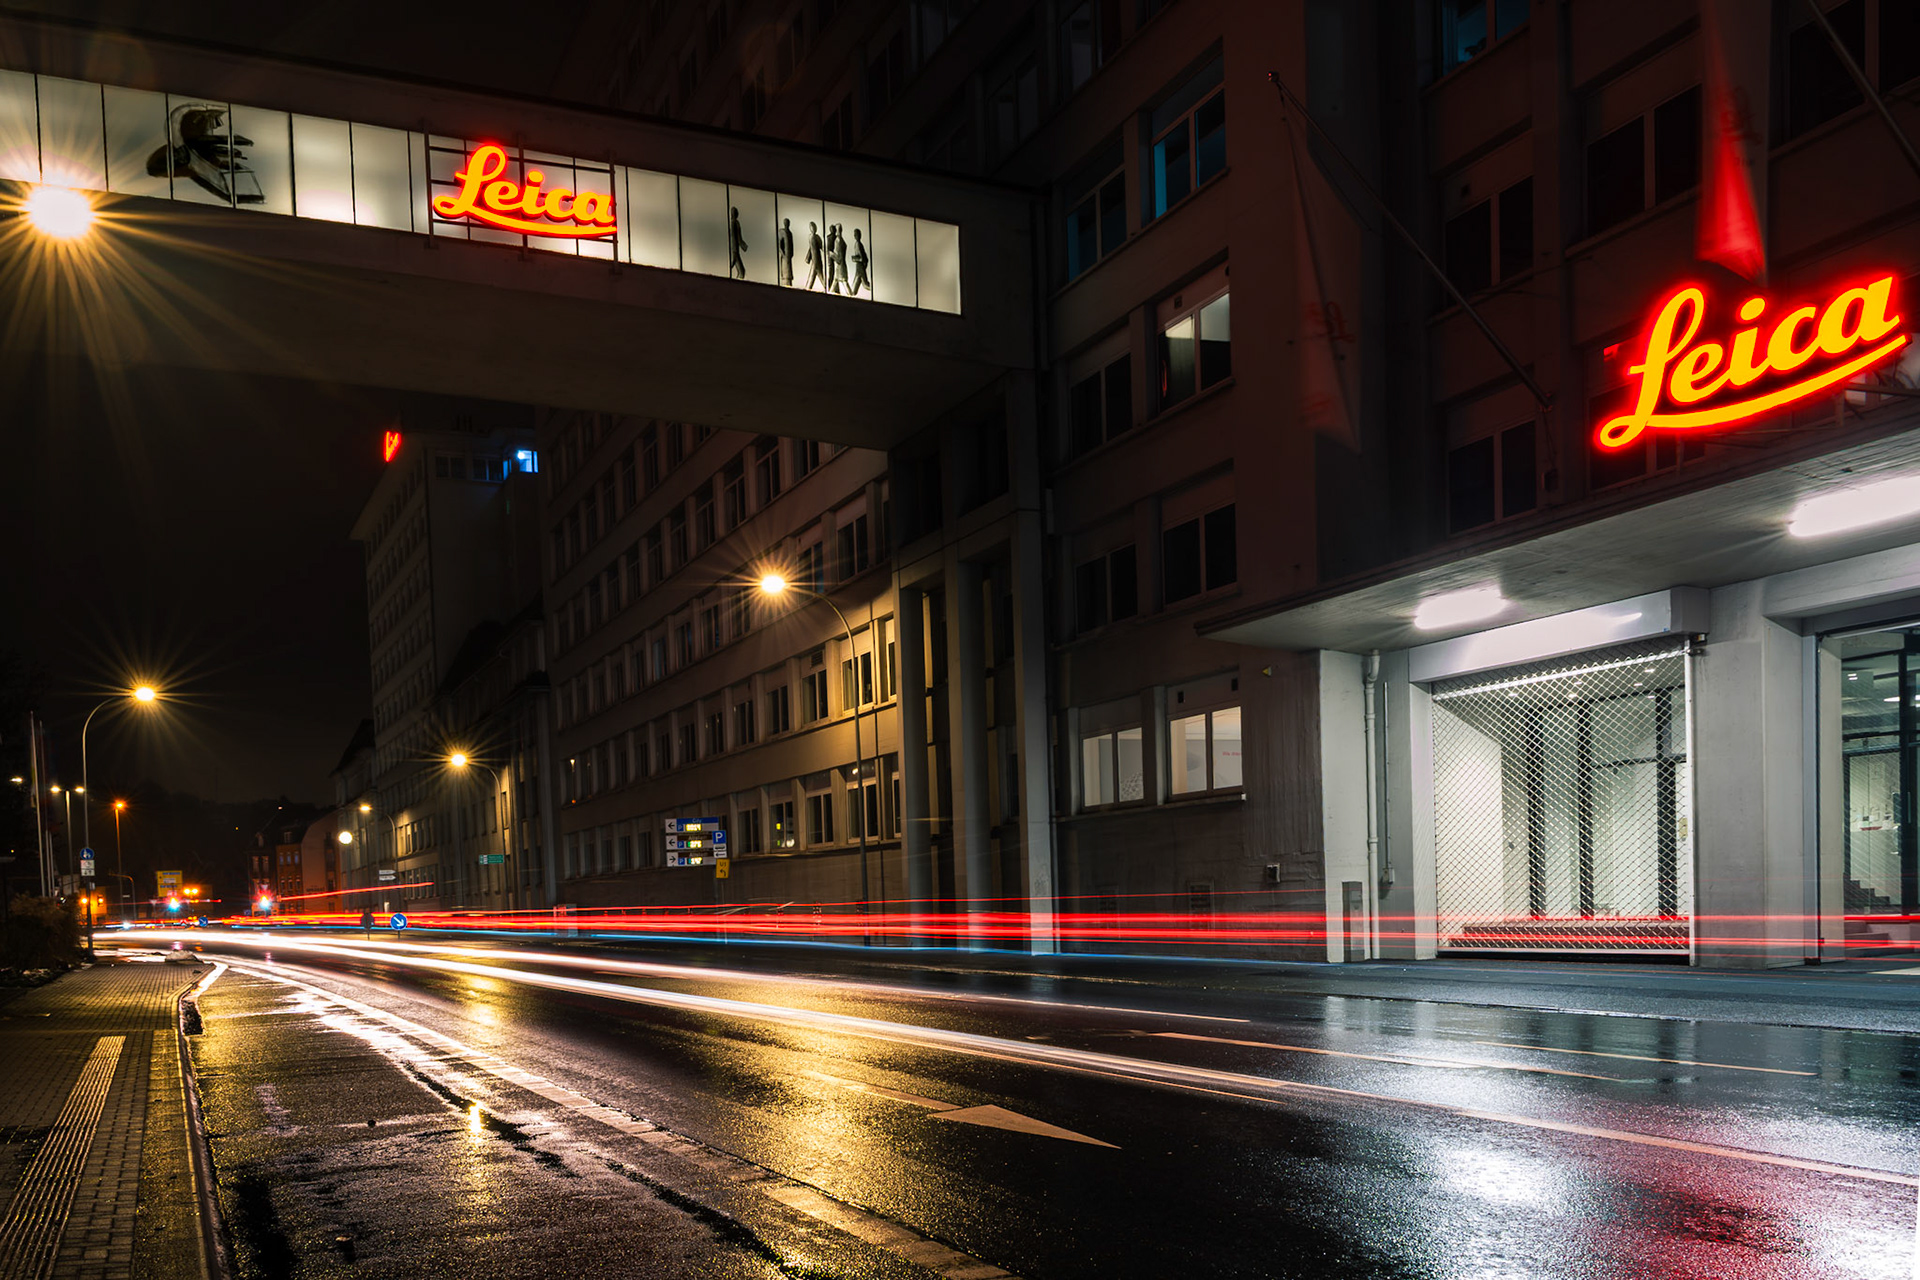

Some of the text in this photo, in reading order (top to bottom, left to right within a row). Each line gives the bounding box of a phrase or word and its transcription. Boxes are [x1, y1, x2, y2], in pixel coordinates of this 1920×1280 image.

[434, 145, 617, 236] Leica
[1600, 276, 1906, 447] Leica
[715, 832, 723, 842] P
